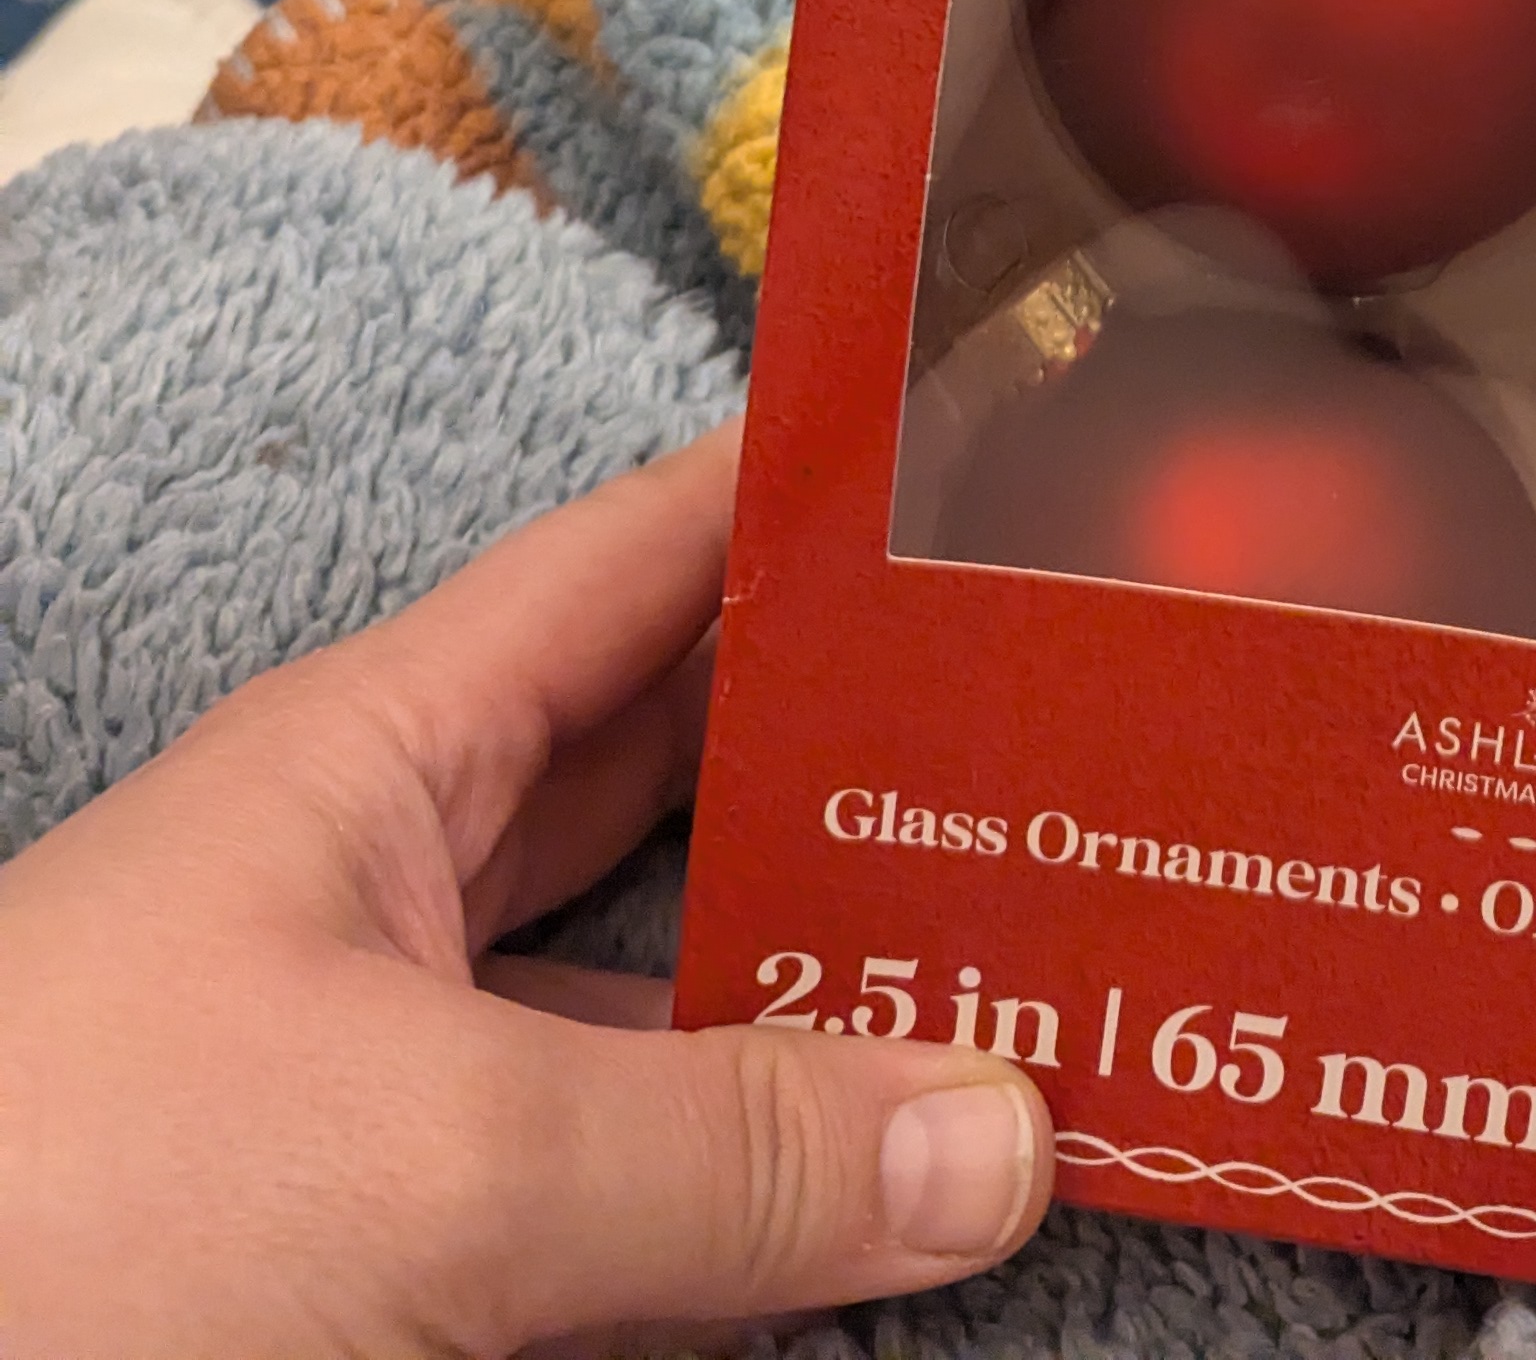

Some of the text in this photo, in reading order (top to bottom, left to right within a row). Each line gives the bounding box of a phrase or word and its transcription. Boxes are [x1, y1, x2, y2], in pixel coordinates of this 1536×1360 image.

[823, 787, 1009, 857] Glass
[1026, 810, 1422, 918] Ornaments
[752, 951, 919, 1040] 2.5
[949, 966, 1062, 1069] in
[1151, 1005, 1289, 1104] 65
